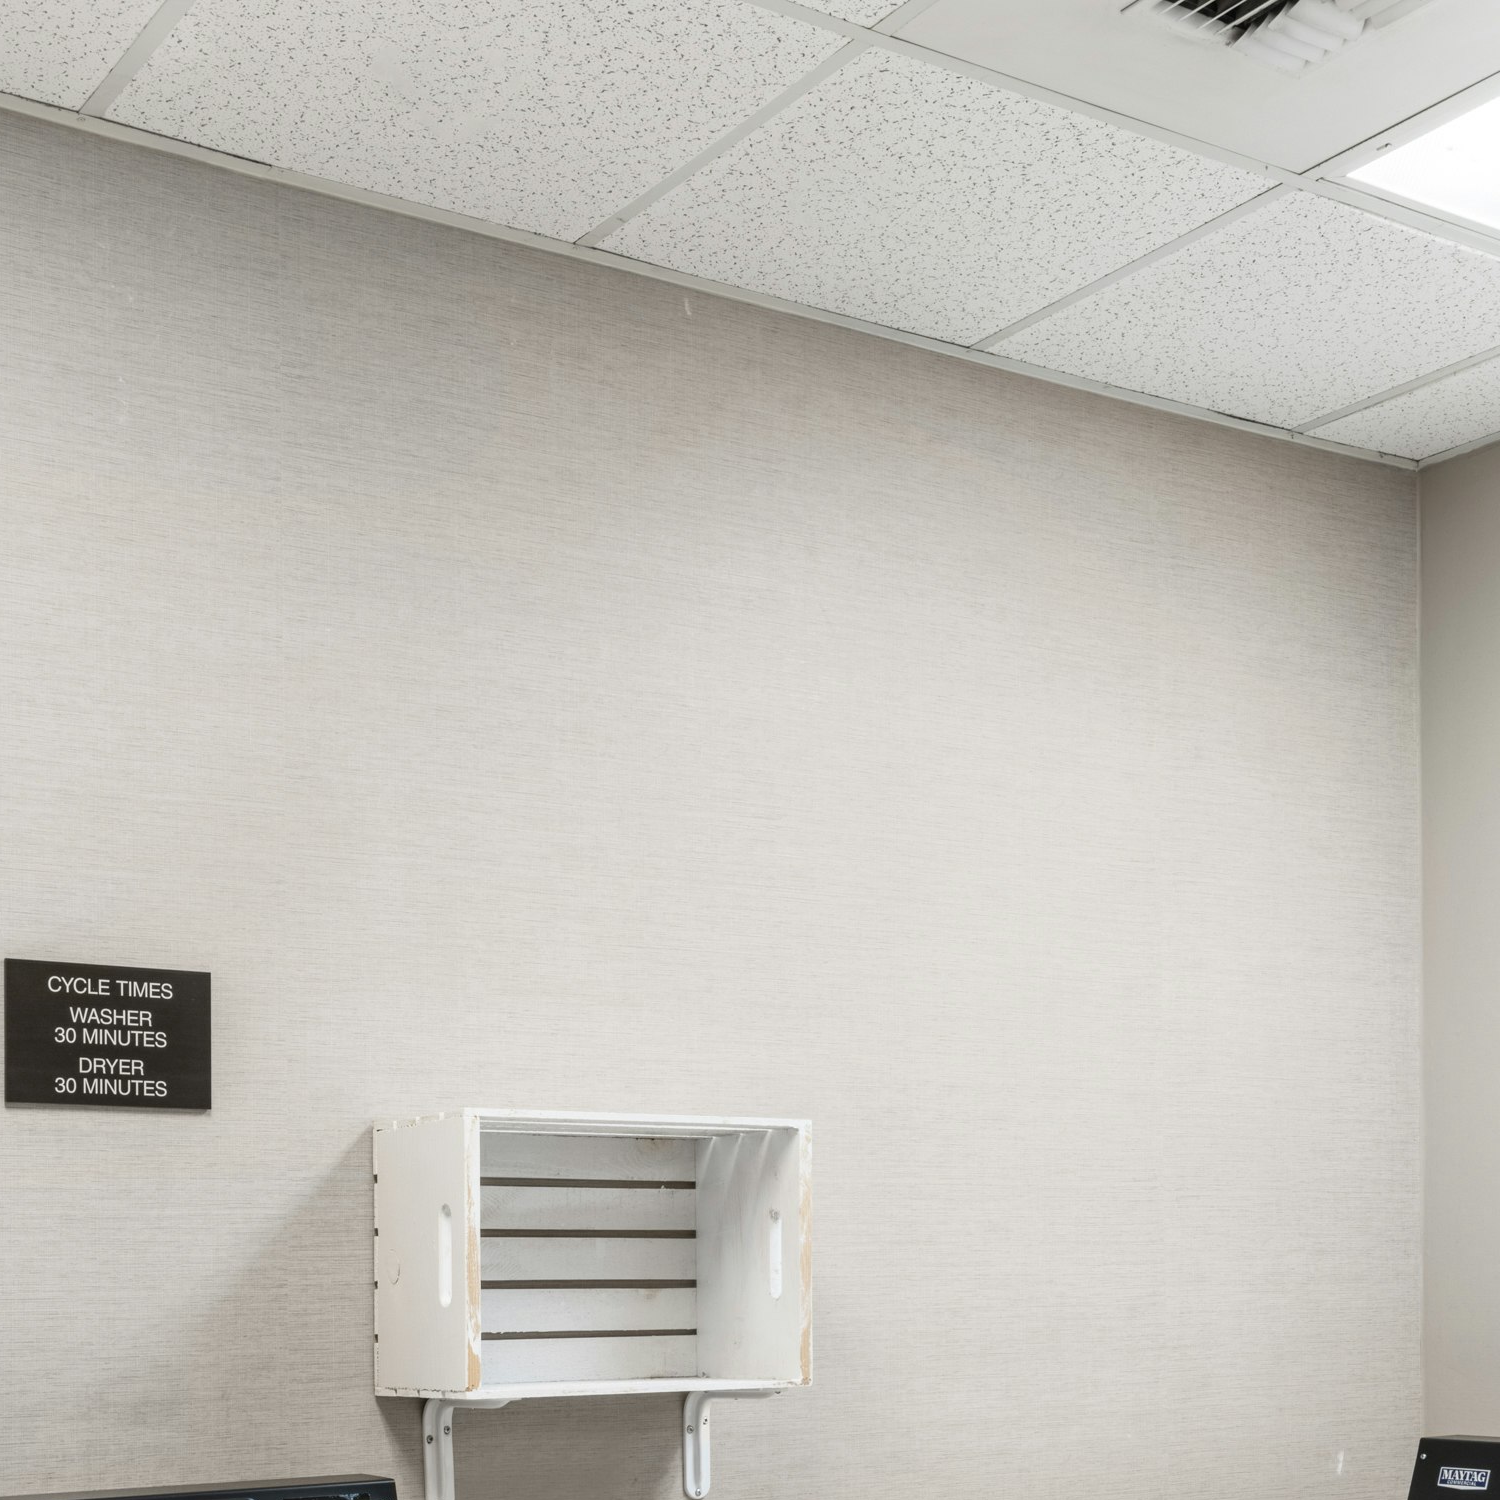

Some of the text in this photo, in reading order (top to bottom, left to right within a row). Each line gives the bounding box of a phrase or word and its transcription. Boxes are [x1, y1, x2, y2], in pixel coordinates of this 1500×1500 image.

[47, 976, 173, 999] CYCLE TIMES
[69, 1007, 152, 1027] WASHER
[55, 1028, 167, 1048] 30 MINUTES
[79, 1057, 144, 1076] DRYER
[55, 1078, 168, 1097] 30 MINUTES
[1442, 1469, 1486, 1482] MAYTAG
